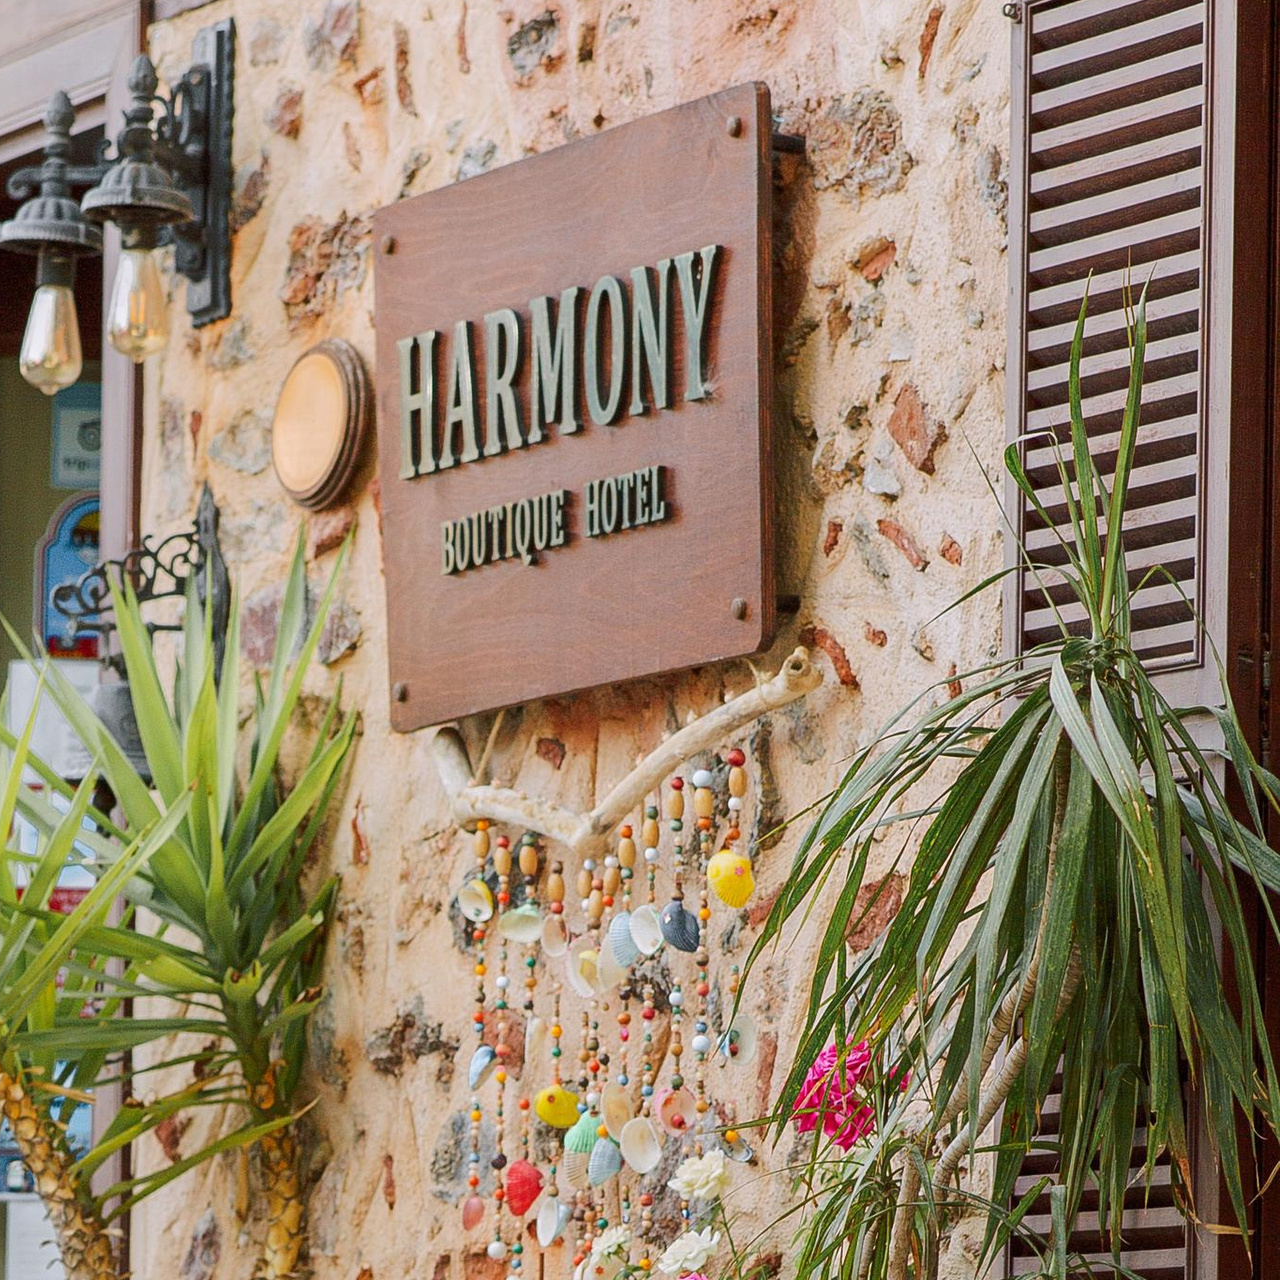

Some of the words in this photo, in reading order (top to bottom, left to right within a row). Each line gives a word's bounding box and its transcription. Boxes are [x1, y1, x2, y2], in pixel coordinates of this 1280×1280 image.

[397, 244, 723, 480] HARMONY
[440, 489, 570, 575] BOUTIQUE
[583, 465, 667, 538] HOTEL
